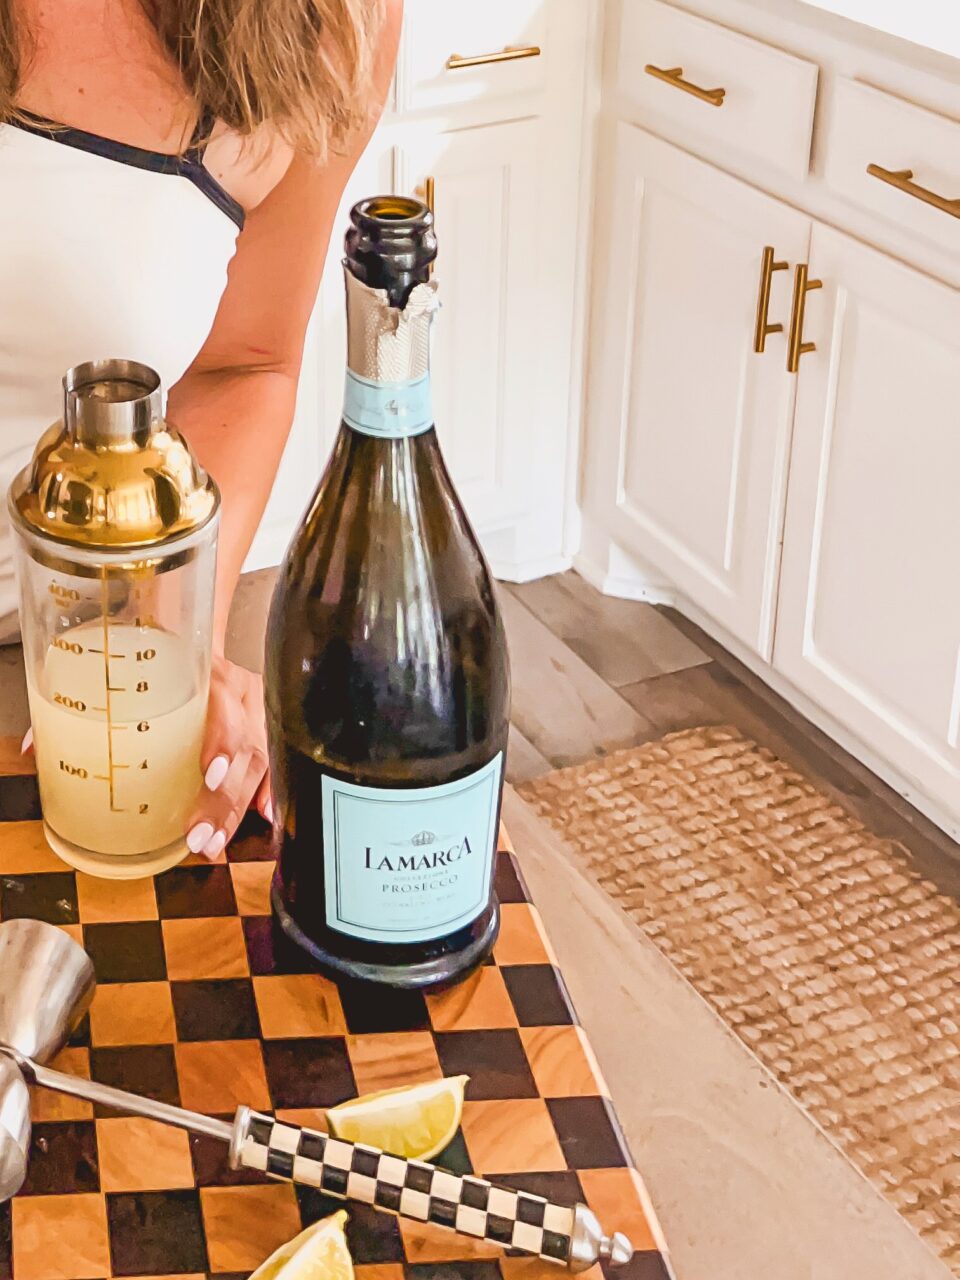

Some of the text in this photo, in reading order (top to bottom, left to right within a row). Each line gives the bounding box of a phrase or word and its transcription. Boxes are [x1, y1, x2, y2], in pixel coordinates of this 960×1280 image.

[136, 649, 156, 661] 10
[136, 681, 149, 692] 8
[54, 692, 86, 712] 200
[136, 721, 150, 732] 6
[60, 760, 88, 779] 100
[138, 804, 149, 815] 2
[382, 875, 458, 893] PROSECCO
